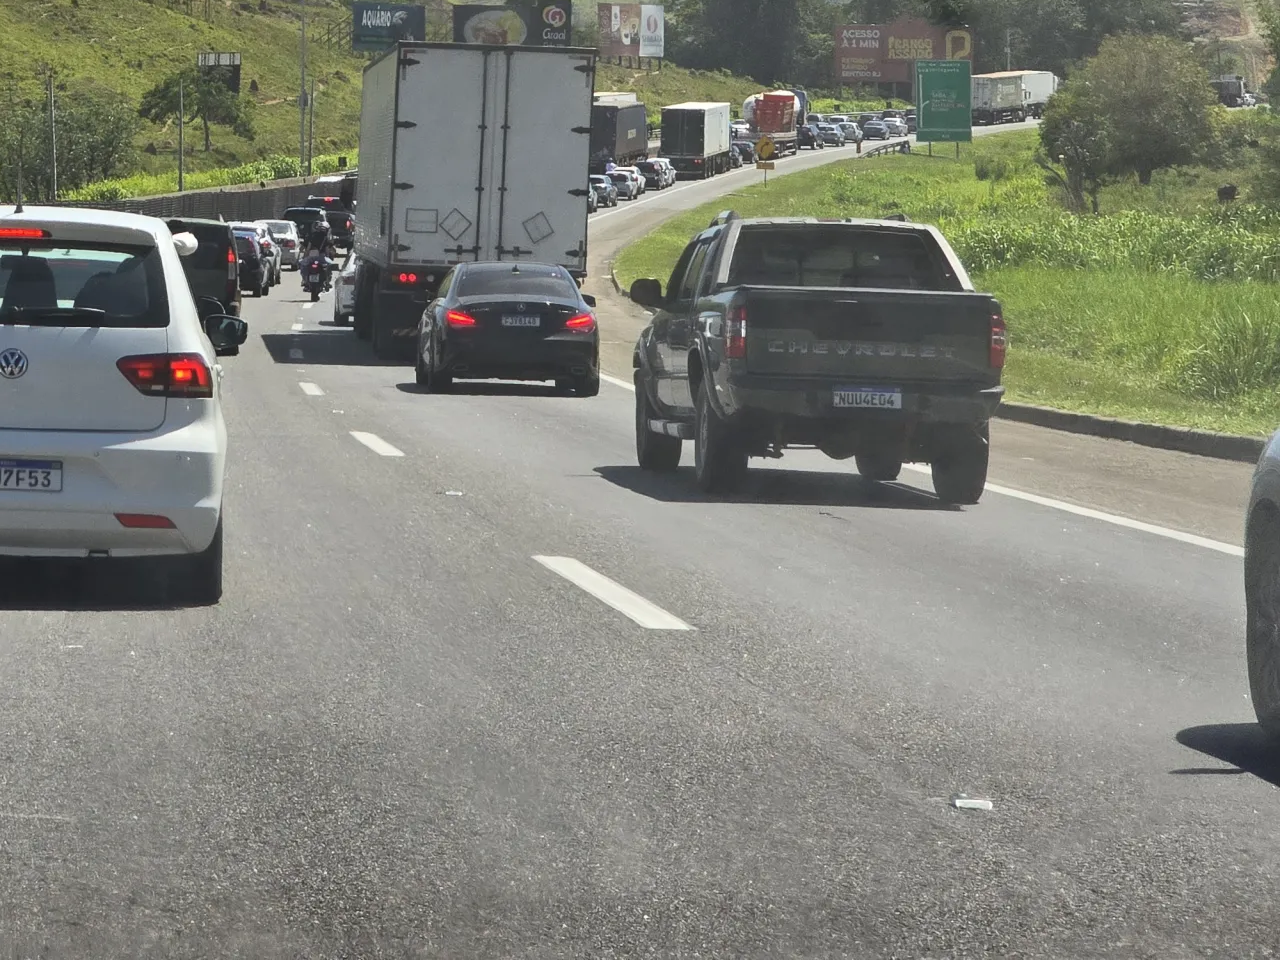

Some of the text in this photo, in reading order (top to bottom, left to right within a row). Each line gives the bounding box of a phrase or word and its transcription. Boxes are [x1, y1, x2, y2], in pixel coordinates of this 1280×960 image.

[361, 5, 392, 28] AQUÁRIO
[542, 28, 566, 40] Graal
[842, 29, 880, 38] ACESSO
[852, 40, 857, 48] 1
[860, 40, 879, 49] MIN
[888, 48, 933, 59] ASSADO
[768, 340, 955, 359] CHEVROLET
